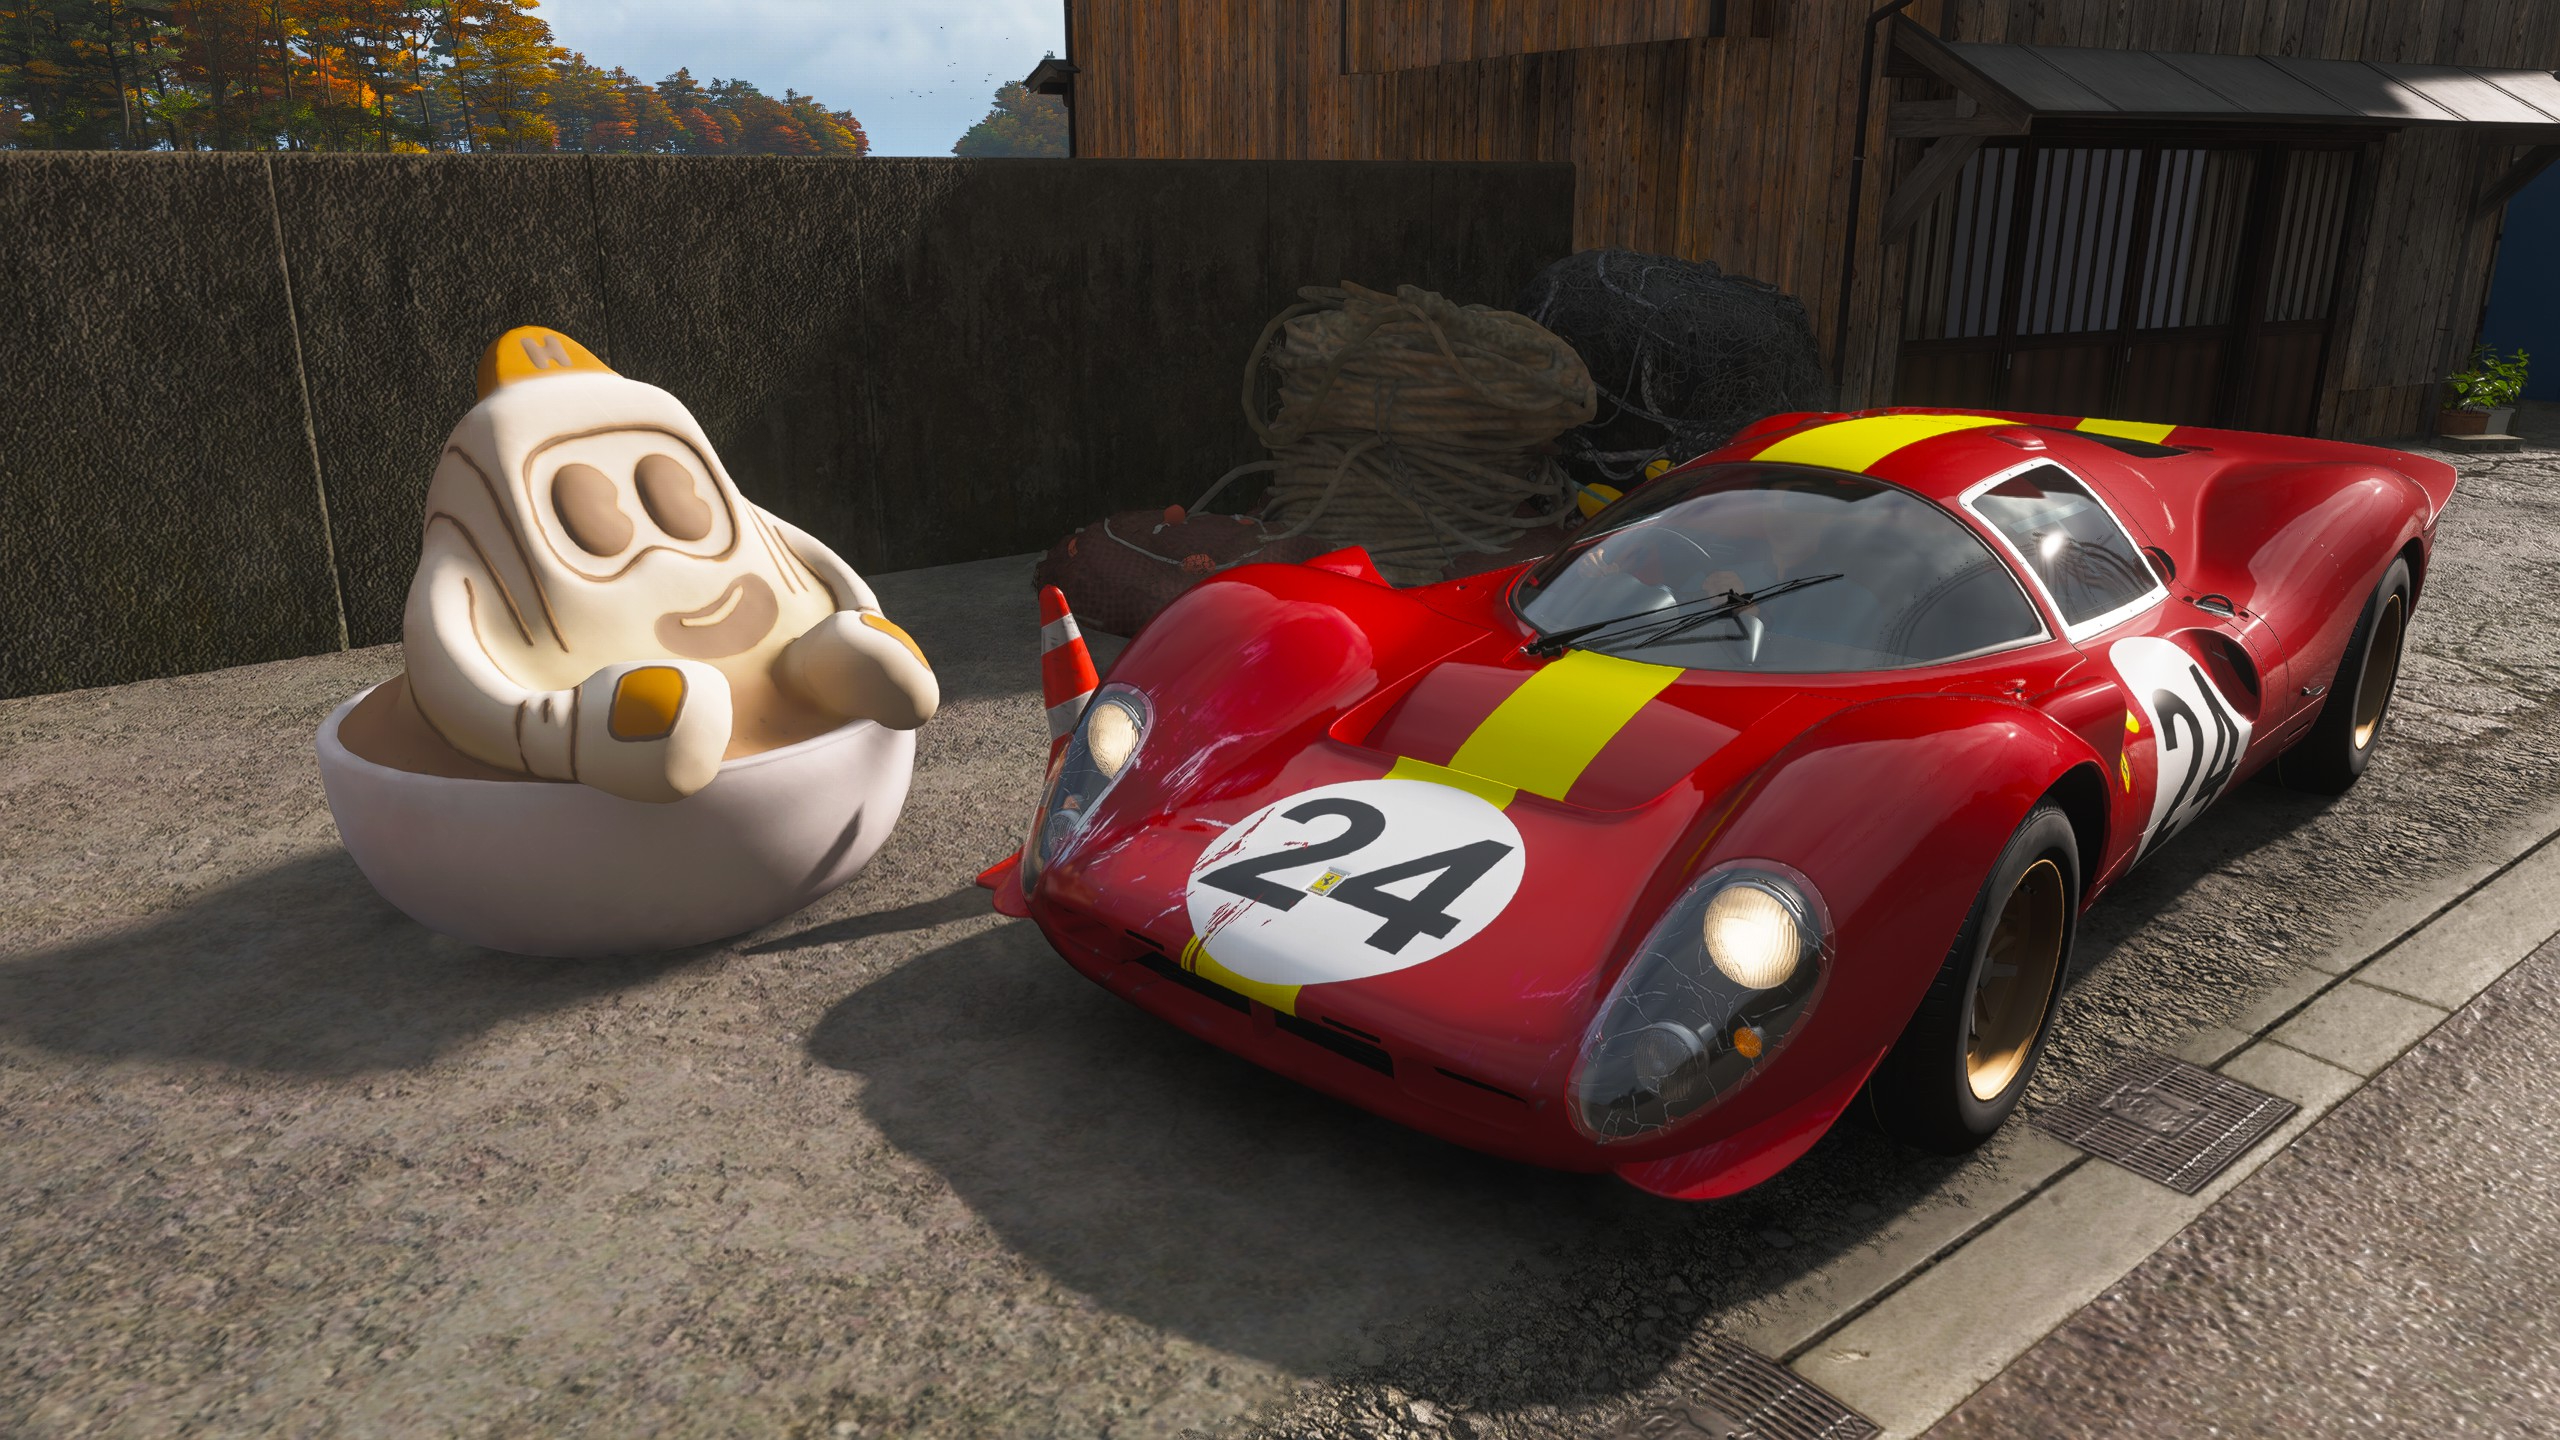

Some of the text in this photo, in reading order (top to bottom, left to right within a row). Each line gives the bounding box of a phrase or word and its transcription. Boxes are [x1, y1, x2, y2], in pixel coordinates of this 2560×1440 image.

[520, 335, 573, 369] H
[2130, 664, 2239, 869] 24
[1198, 798, 1514, 955] 24
